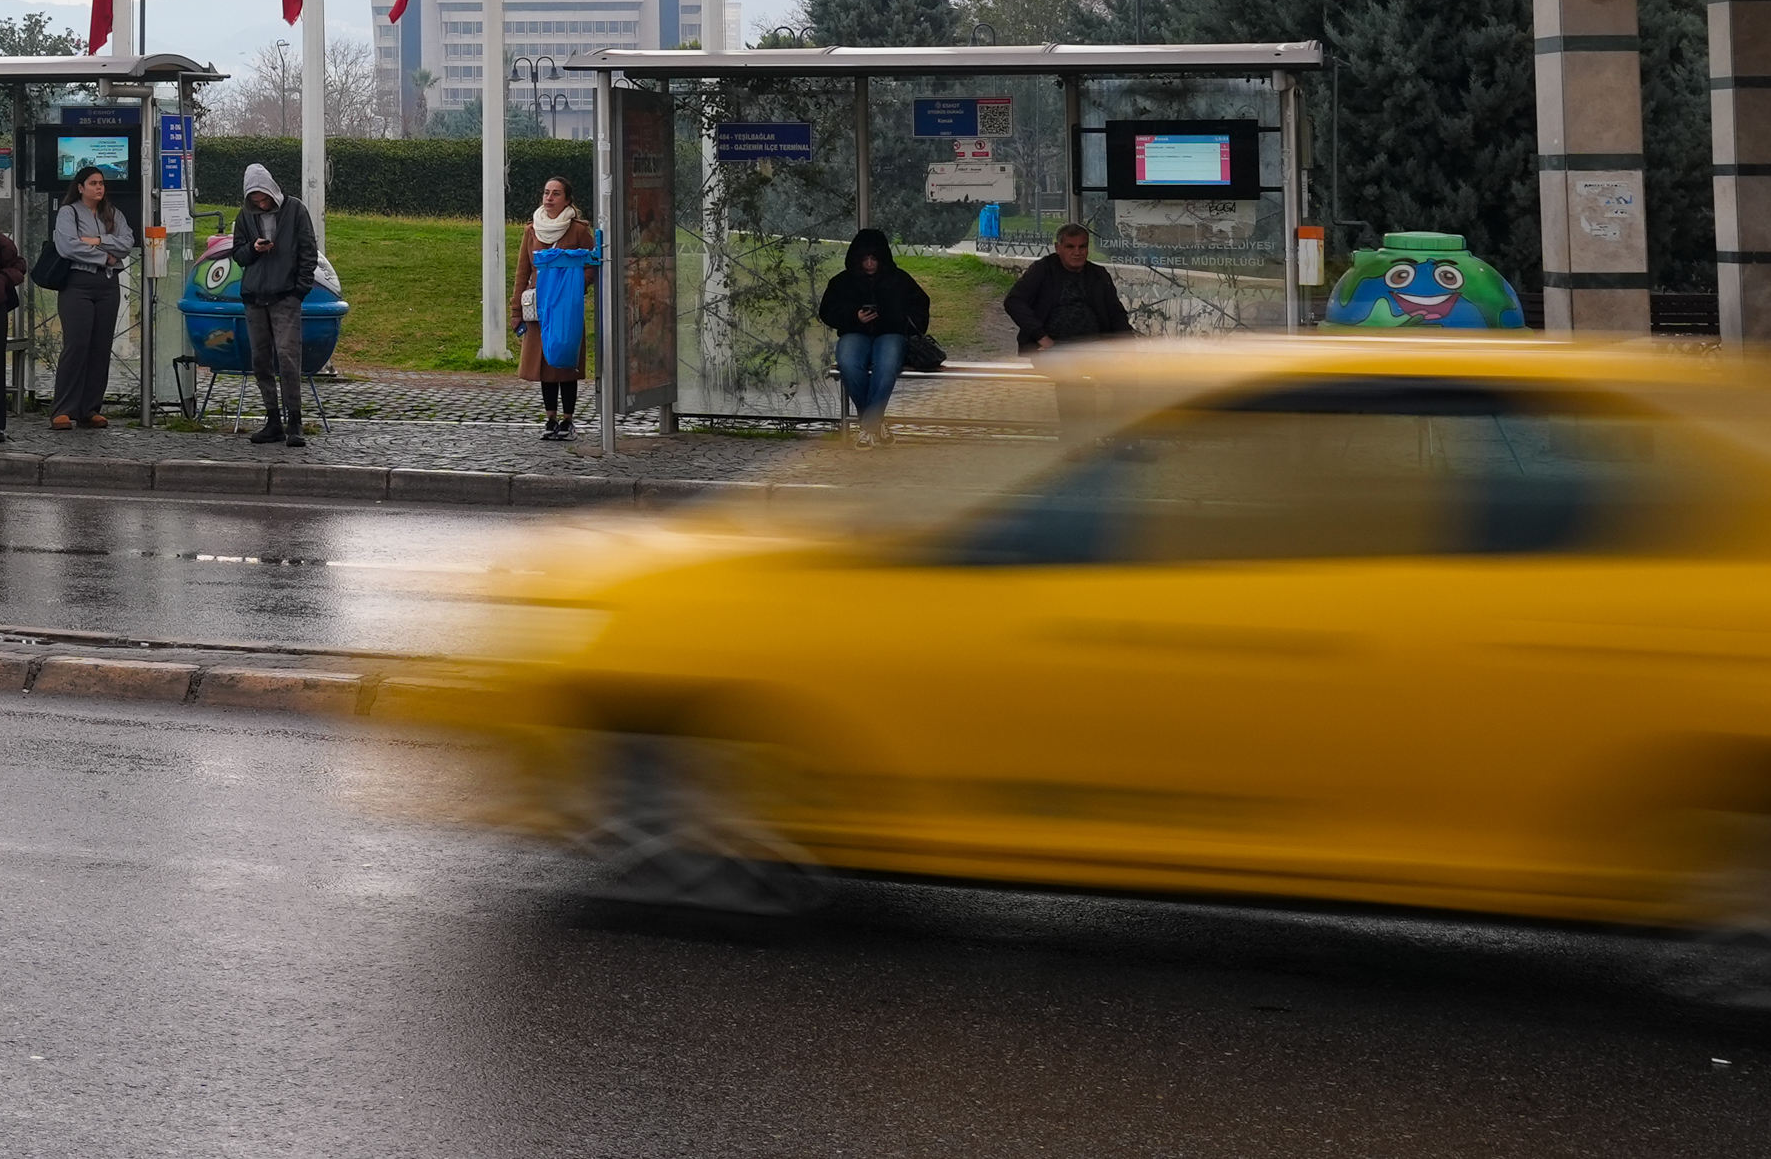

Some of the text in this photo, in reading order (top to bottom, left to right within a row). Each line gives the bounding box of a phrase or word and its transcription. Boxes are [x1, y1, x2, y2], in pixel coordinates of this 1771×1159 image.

[78, 117, 92, 125] 285
[97, 117, 116, 125] EVKA
[118, 117, 122, 125] 1
[734, 132, 775, 141] YEŞİLBAĞLAR
[734, 143, 763, 151] GAZİEMİR
[764, 143, 778, 152] İLÇE
[779, 143, 810, 151] TERMİNAL
[1100, 238, 1129, 248] İZMİR
[1110, 256, 1148, 264] ESHOT
[1150, 256, 1188, 266] GENEL
